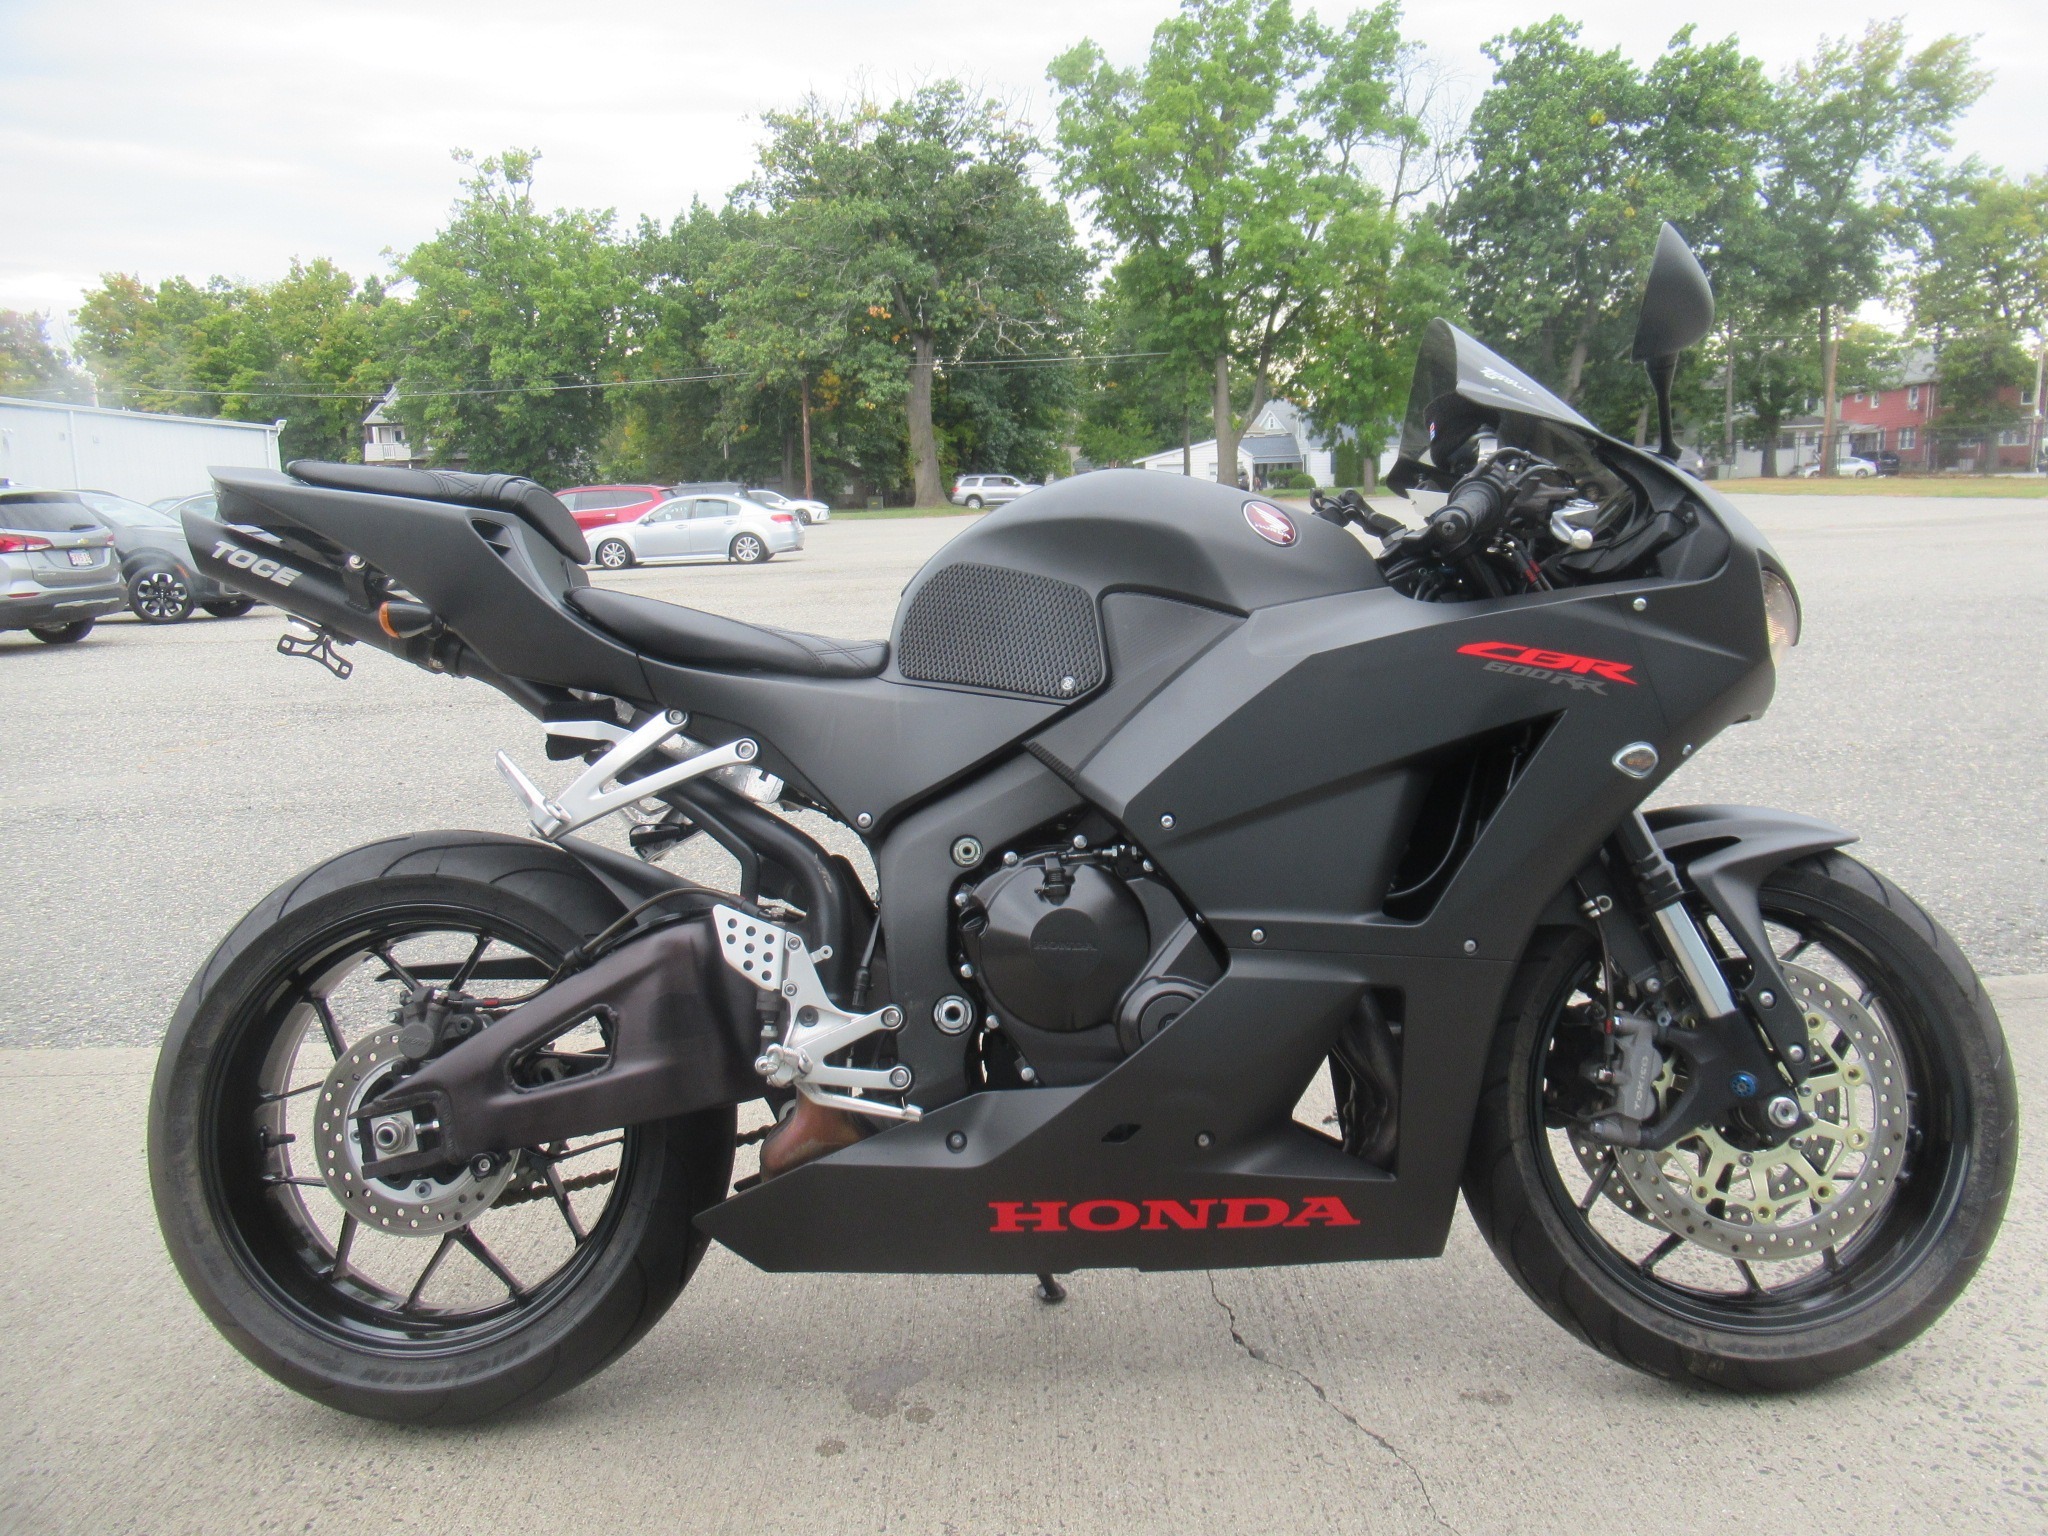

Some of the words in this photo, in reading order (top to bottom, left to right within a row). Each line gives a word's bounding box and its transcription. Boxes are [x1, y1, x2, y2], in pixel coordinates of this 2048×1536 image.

[211, 541, 303, 587] TOCE
[1456, 641, 1638, 685] CBR
[1482, 661, 1608, 696] 600RR
[988, 1196, 1361, 1233] HONDA
